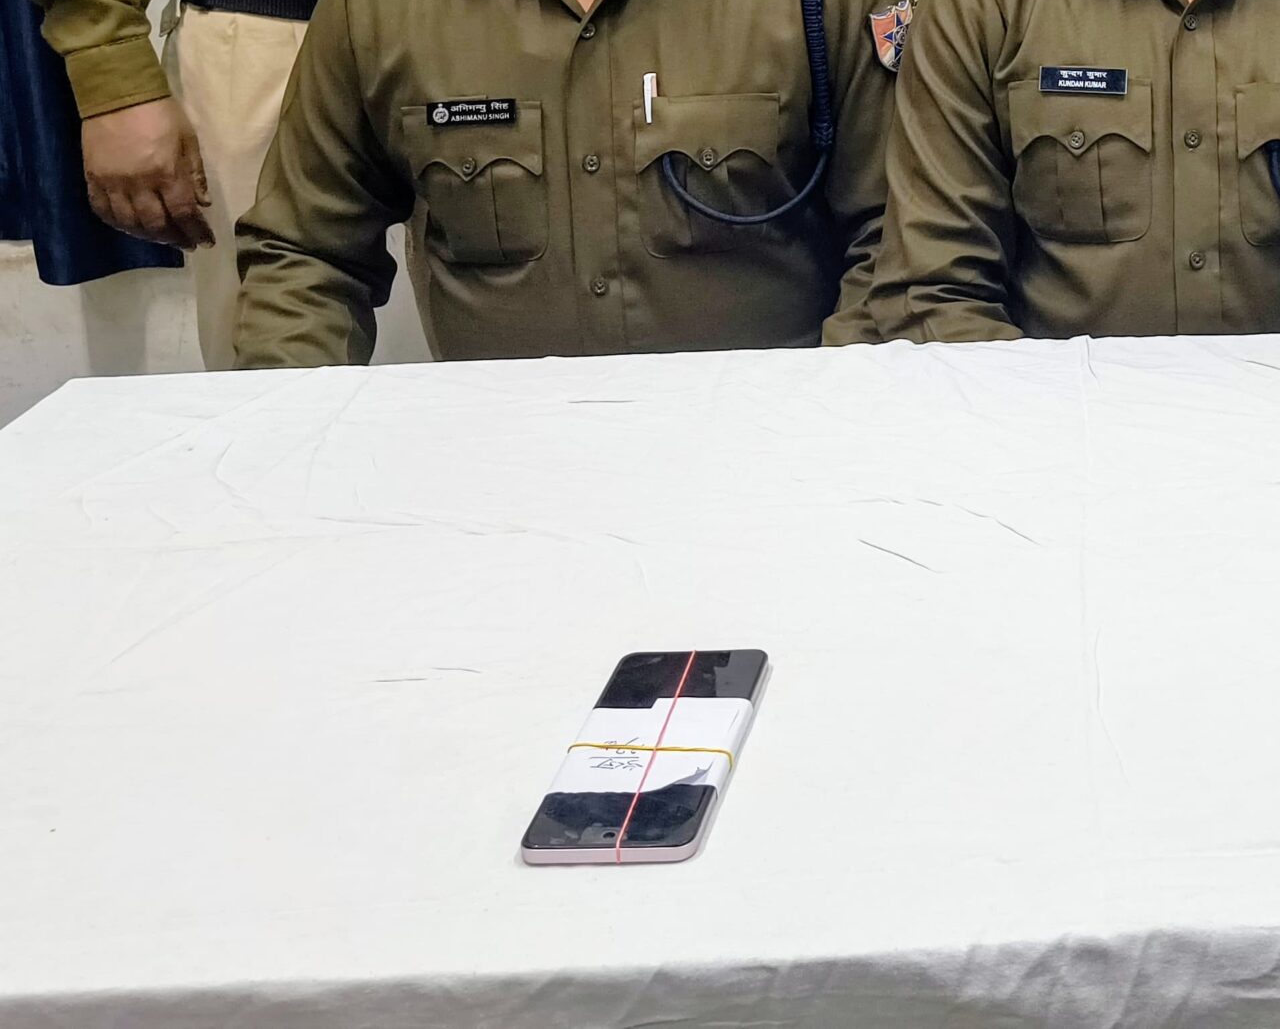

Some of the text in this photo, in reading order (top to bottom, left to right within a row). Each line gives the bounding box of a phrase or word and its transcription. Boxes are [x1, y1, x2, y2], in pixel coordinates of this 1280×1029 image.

[1058, 80, 1107, 89] KUNDAN KUMAR
[488, 112, 510, 120] SINGH
